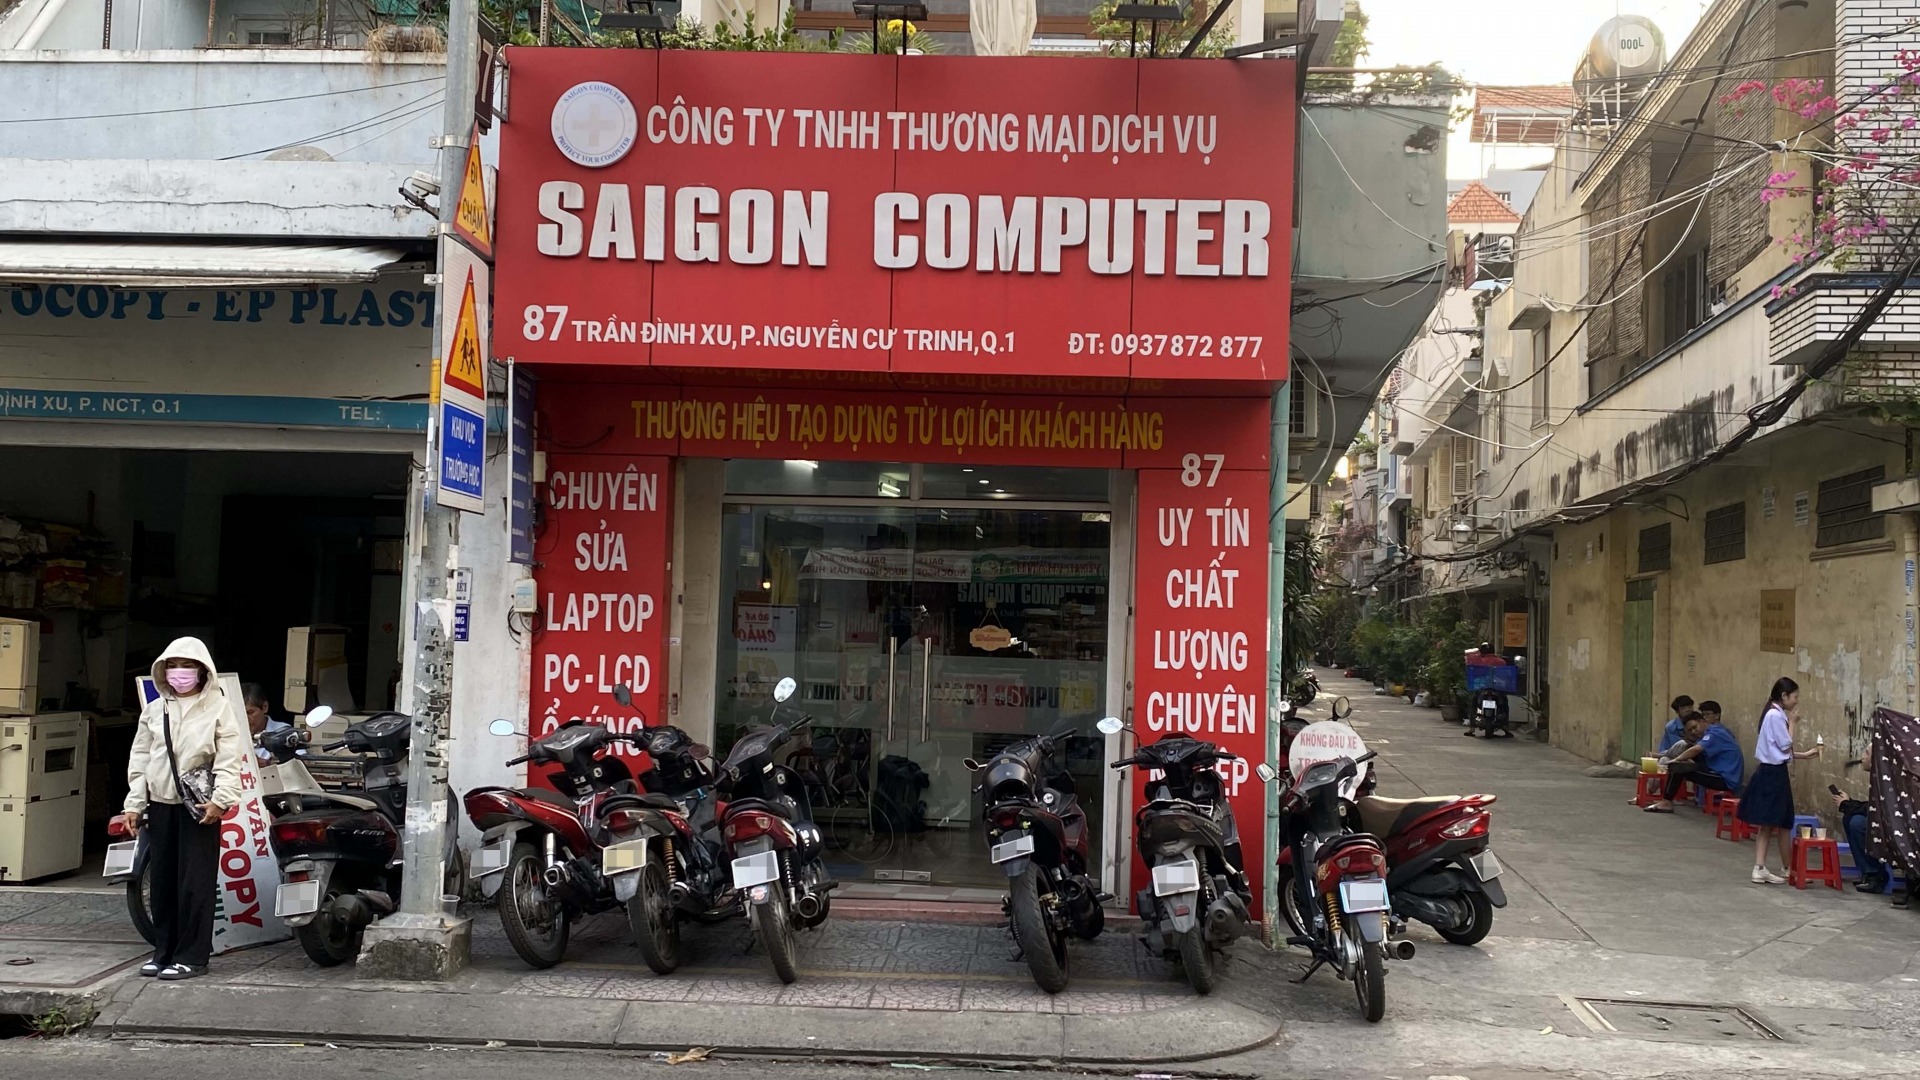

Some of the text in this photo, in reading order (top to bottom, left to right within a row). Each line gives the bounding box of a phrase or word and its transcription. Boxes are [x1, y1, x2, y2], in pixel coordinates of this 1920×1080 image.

[475, 32, 493, 103] 7
[1618, 37, 1644, 49] 000L
[563, 84, 626, 105] SAIGON COMPUTER
[558, 135, 631, 163] PROTECT YOUR COMPUTER
[647, 95, 1217, 165] CÔNG TY TNHH THƯƠNG MẠI DỊCH VỤ
[470, 161, 478, 187] ĐI
[462, 197, 484, 234] CHẬM
[537, 181, 1271, 277] SAIGON COMPUTER
[523, 305, 568, 341] 87
[572, 314, 636, 343] TRẦN
[640, 317, 695, 345] ĐÌNH
[863, 328, 898, 350] CƯ
[1068, 333, 1105, 355] ĐT:
[1220, 336, 1263, 358] 877
[43, 396, 72, 412] XU,
[80, 397, 95, 412] P.
[103, 399, 145, 414] NCT,
[153, 400, 180, 414] Q.1
[339, 406, 380, 421] TEL:
[451, 415, 476, 448] KHU VỰC
[631, 394, 1164, 455] THƯƠNG HIỆU TẠO DỰNG TỪ LỢI ÍCH KHÁCH HÀNG
[445, 453, 480, 490] TRƯỜNG HỌC
[549, 463, 657, 512] CHUYÊN
[1181, 453, 1225, 487] 87
[574, 519, 628, 571] SỬA
[1159, 497, 1249, 546] UY TÍN
[1166, 552, 1239, 608] CHẤT
[547, 593, 654, 632] LAPTOP
[1154, 628, 1248, 680] LƯỢNG
[1147, 684, 1256, 734] CHUYÊN
[1300, 730, 1327, 748] KHÔNG
[1347, 736, 1358, 749] XE
[246, 797, 270, 858] VÂN
